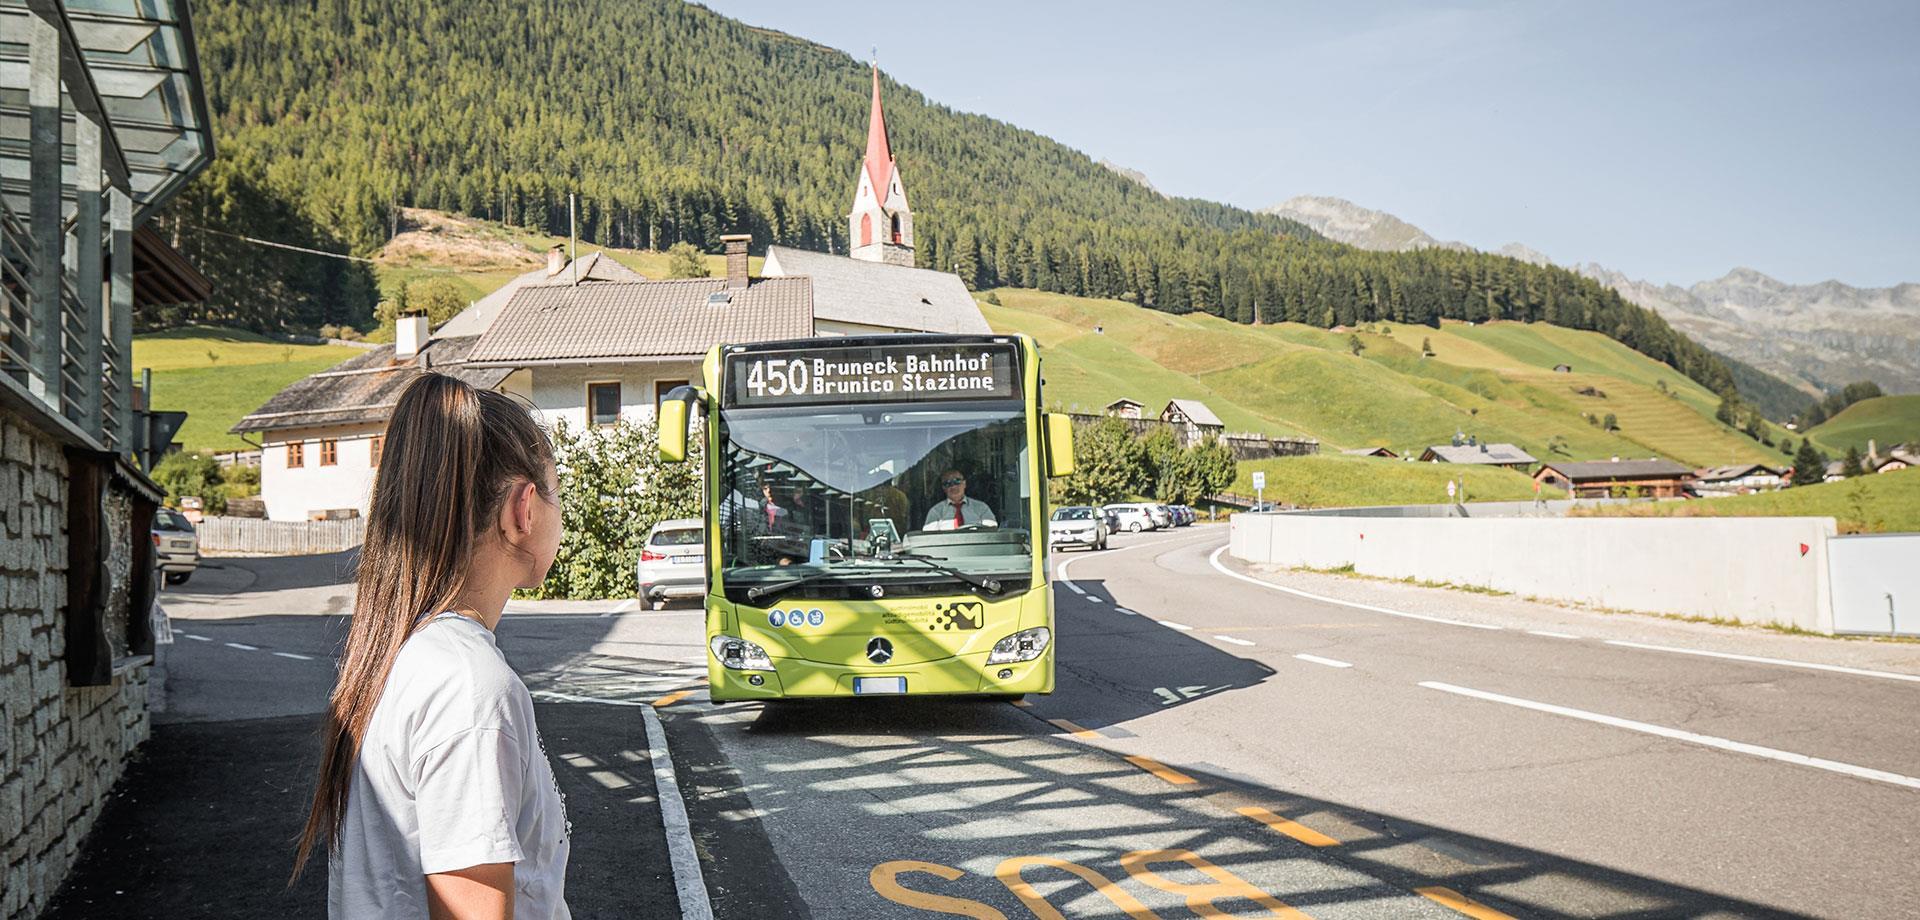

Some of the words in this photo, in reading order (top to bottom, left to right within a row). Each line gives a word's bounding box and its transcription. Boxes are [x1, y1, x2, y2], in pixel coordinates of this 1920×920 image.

[813, 356, 898, 376] Bruneck
[906, 352, 990, 373] Bahnhof
[747, 359, 808, 396] 450
[812, 376, 894, 394] Brunico
[902, 373, 994, 391] Stazione
